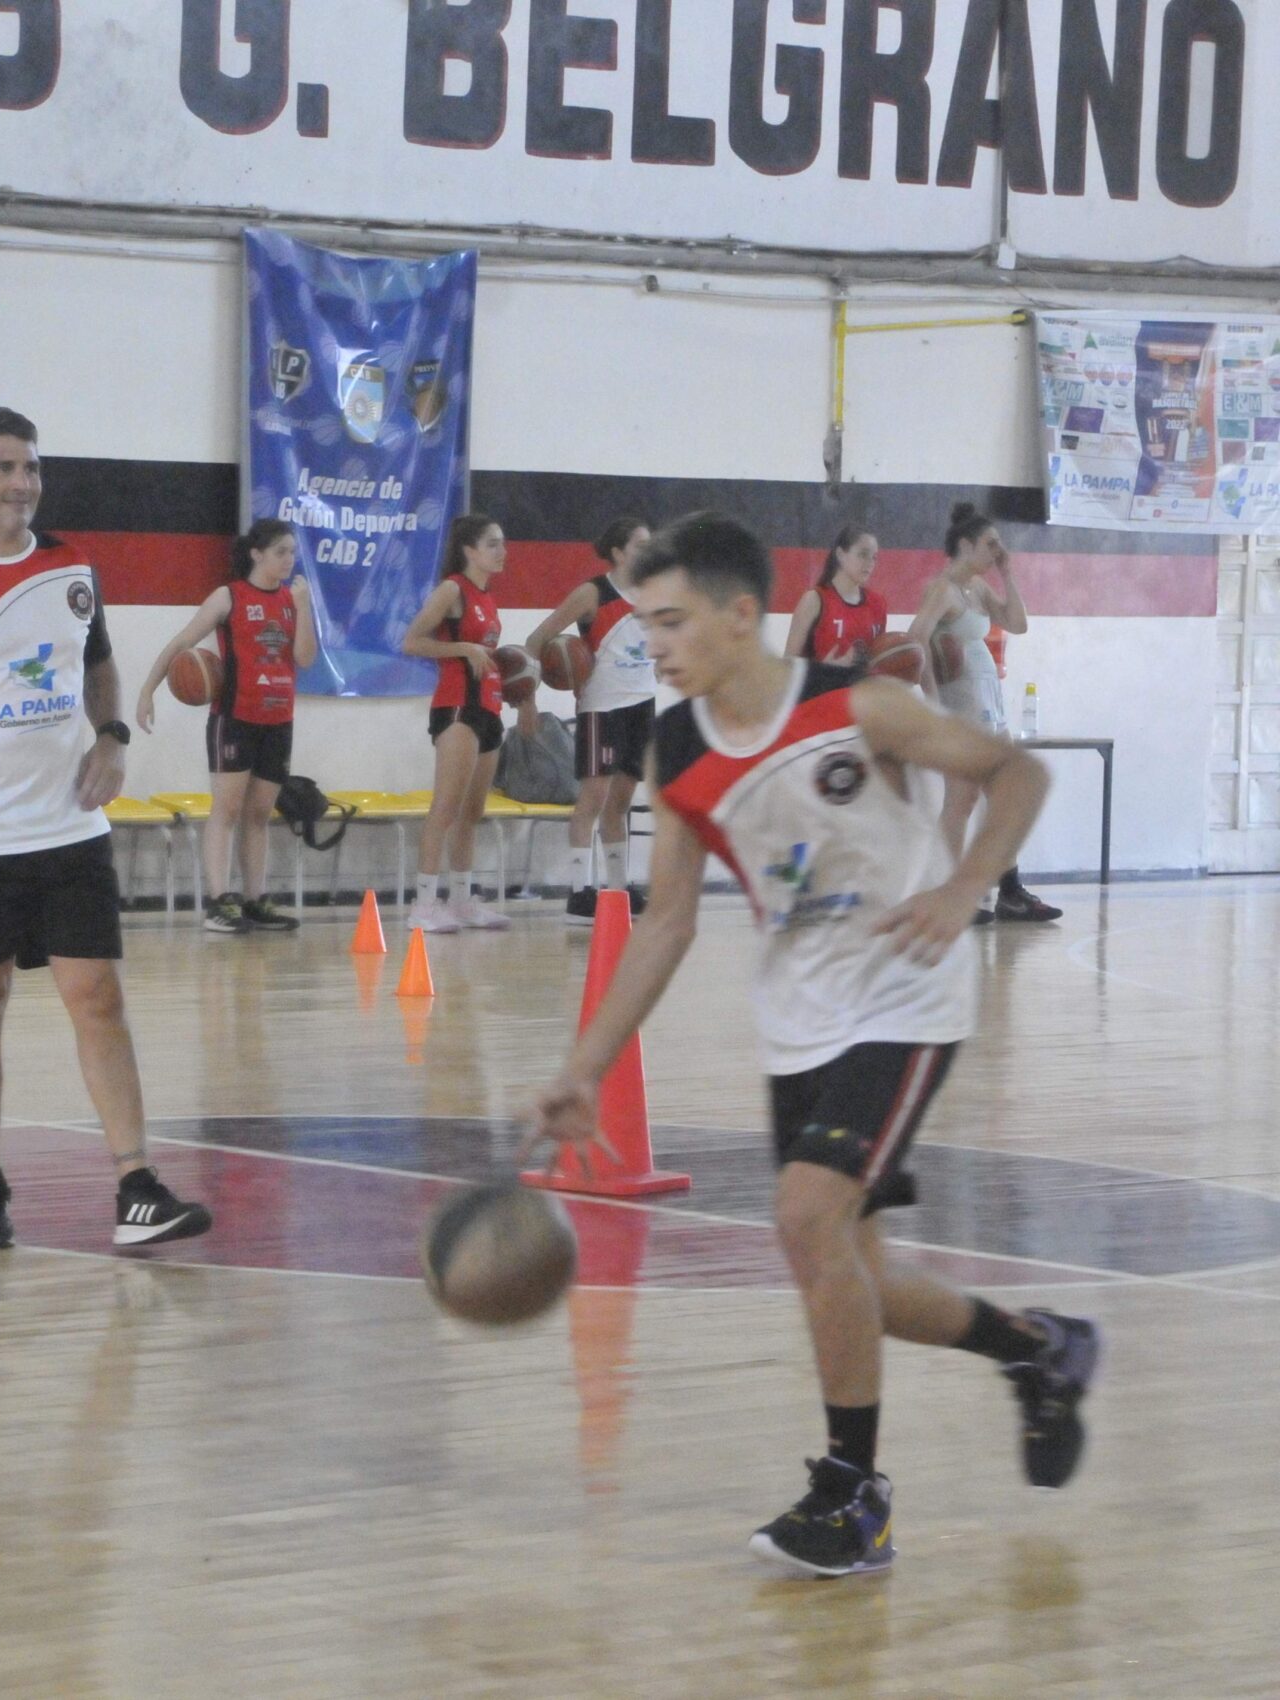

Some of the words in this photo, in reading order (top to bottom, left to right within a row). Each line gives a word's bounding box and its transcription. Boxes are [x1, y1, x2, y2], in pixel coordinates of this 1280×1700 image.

[404, 0, 1246, 208] BELGRANO
[297, 467, 375, 498] Agencia
[379, 475, 402, 500] de
[316, 538, 360, 566] CAB
[362, 542, 377, 567] 2
[833, 618, 843, 638] 7
